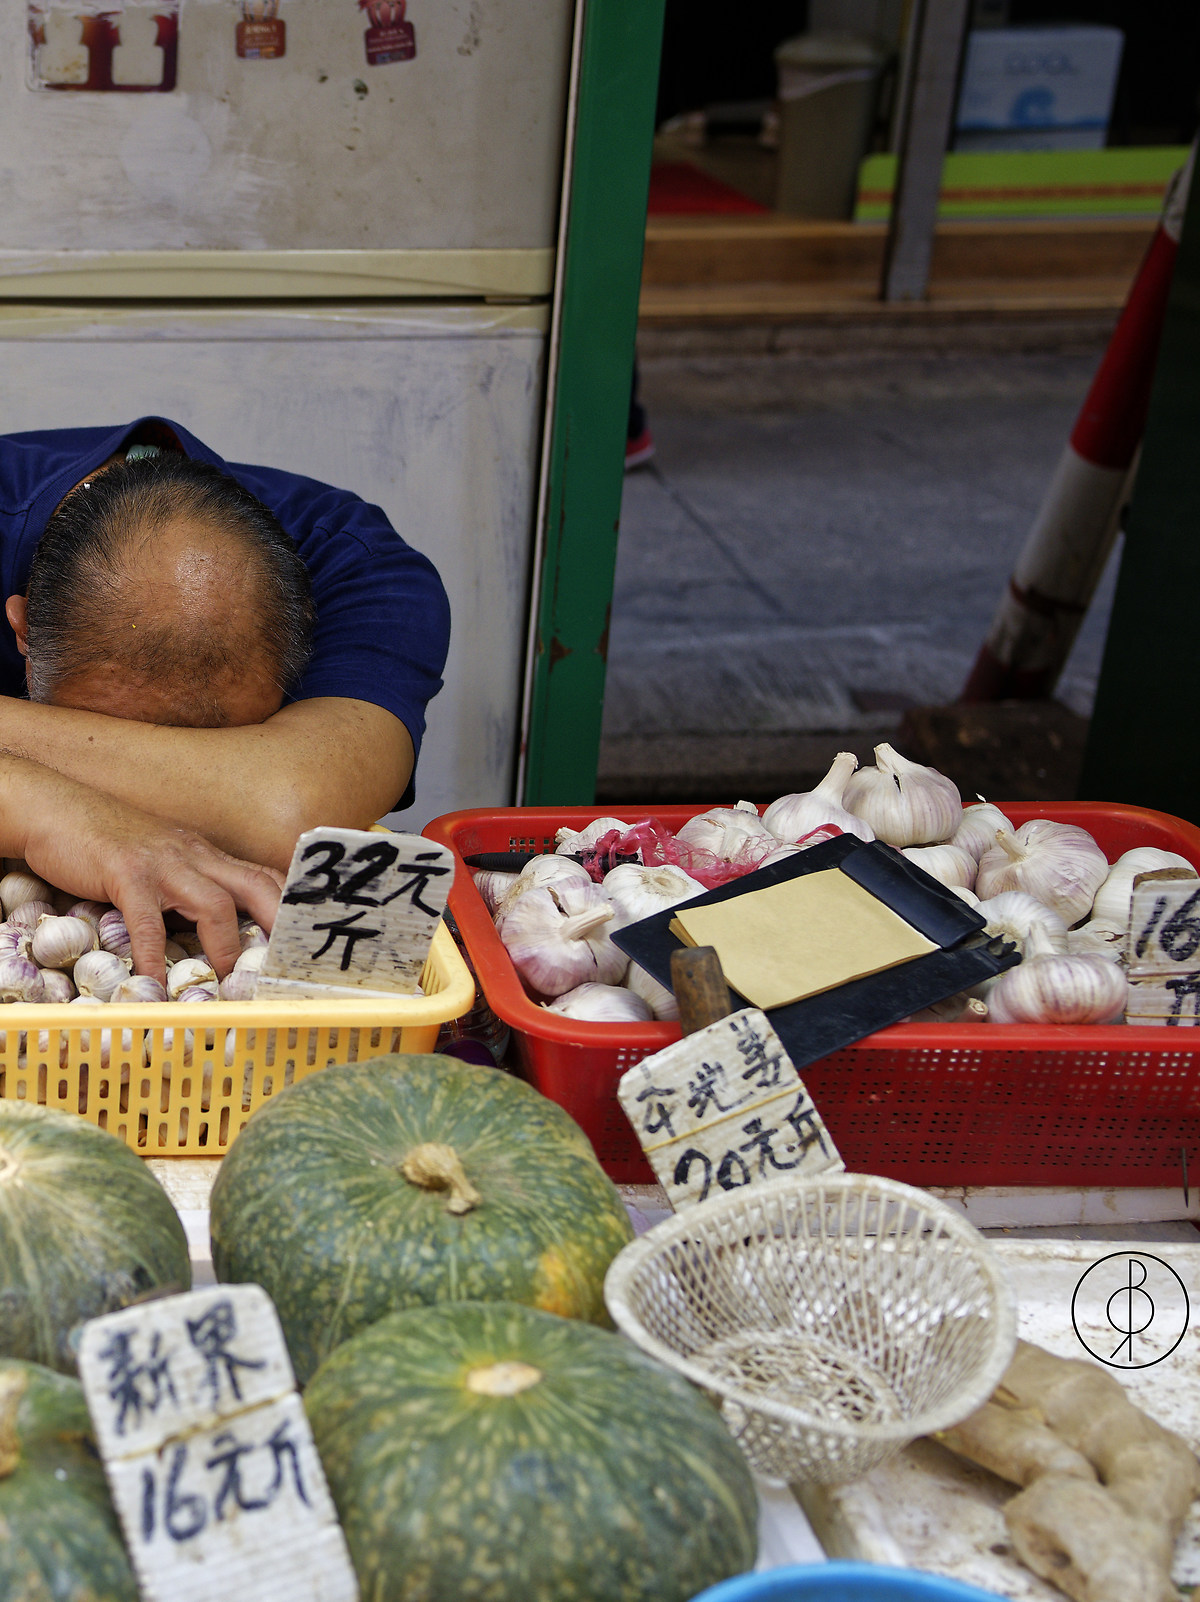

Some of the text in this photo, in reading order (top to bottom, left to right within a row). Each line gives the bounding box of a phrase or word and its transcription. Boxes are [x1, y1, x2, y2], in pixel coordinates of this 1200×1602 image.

[281, 840, 452, 918] 32元
[311, 910, 382, 972] 斤
[98, 1298, 267, 1437] 新界
[140, 1417, 313, 1543] 16元斤
